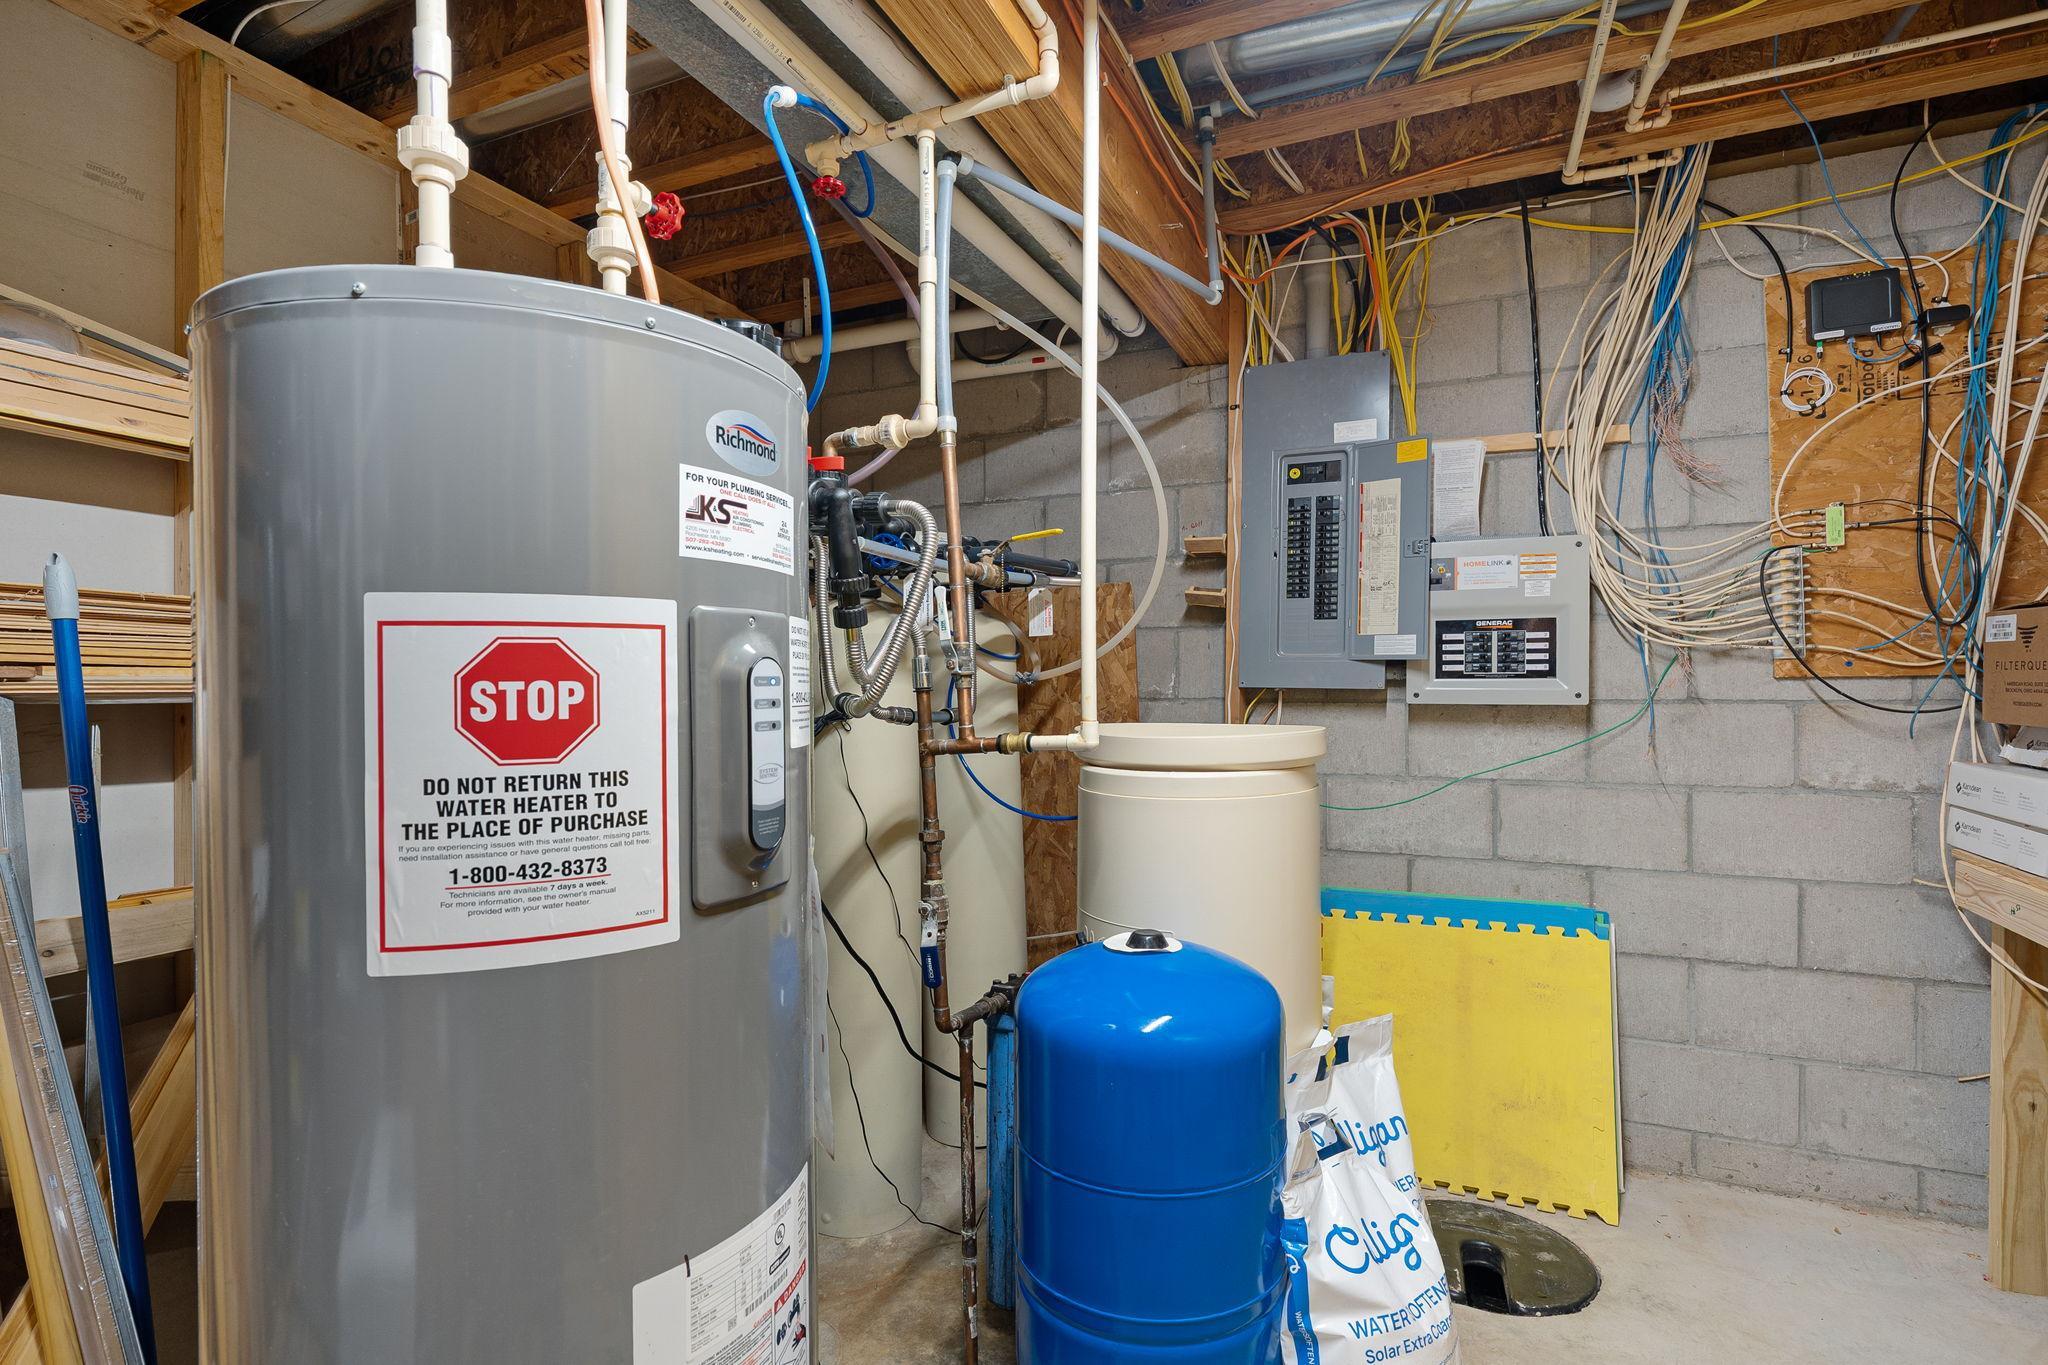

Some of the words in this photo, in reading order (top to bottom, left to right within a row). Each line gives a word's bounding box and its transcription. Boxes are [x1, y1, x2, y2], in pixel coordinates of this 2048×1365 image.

[1863, 349, 1875, 404] norbod
[716, 425, 776, 462] Richmond
[686, 472, 704, 483] FOR
[706, 476, 729, 489] YOUR
[731, 482, 765, 498] PLUMBING
[734, 492, 746, 500] CALL
[748, 496, 761, 504] DOES
[732, 510, 749, 518] HEATING
[740, 517, 765, 526] CONDITIONING
[732, 520, 752, 528] PLUMBING
[732, 525, 755, 534] ELECTRICAL
[685, 545, 744, 558] www.ksheating.com
[1464, 560, 1503, 568] HOMELINK
[1995, 660, 2047, 670] FILTERQUE
[470, 680, 585, 722] STOP
[423, 777, 450, 796] DO
[457, 776, 497, 794] NOT
[504, 772, 582, 792] RETURN
[588, 770, 629, 787] THIS
[1962, 782, 1982, 792] Karndean
[68, 784, 87, 824] Quickie
[436, 798, 506, 817] WATER
[514, 794, 588, 814] HEATER
[594, 791, 618, 808] TO
[402, 823, 439, 840] THE
[447, 820, 511, 839] PLACE
[518, 818, 543, 835] OF
[550, 809, 648, 833] PURCHASE
[1961, 822, 1982, 833] Karndean
[437, 842, 488, 852] experiencing
[541, 846, 570, 855] general
[572, 843, 608, 852] questions
[449, 856, 608, 885] 1-800-432-8373
[449, 891, 496, 899] Technicians
[513, 886, 548, 894] available
[557, 882, 577, 890] days
[479, 897, 525, 906] information,
[558, 891, 587, 899] owner's
[589, 887, 616, 896] manual
[468, 907, 502, 916] provided
[522, 905, 540, 913] your
[565, 899, 591, 907] heater.
[1348, 1308, 1411, 1340] WATER
[1406, 1272, 1448, 1320] OFTENE
[1366, 1345, 1401, 1364] Solar
[1404, 1335, 1433, 1354] Extra
